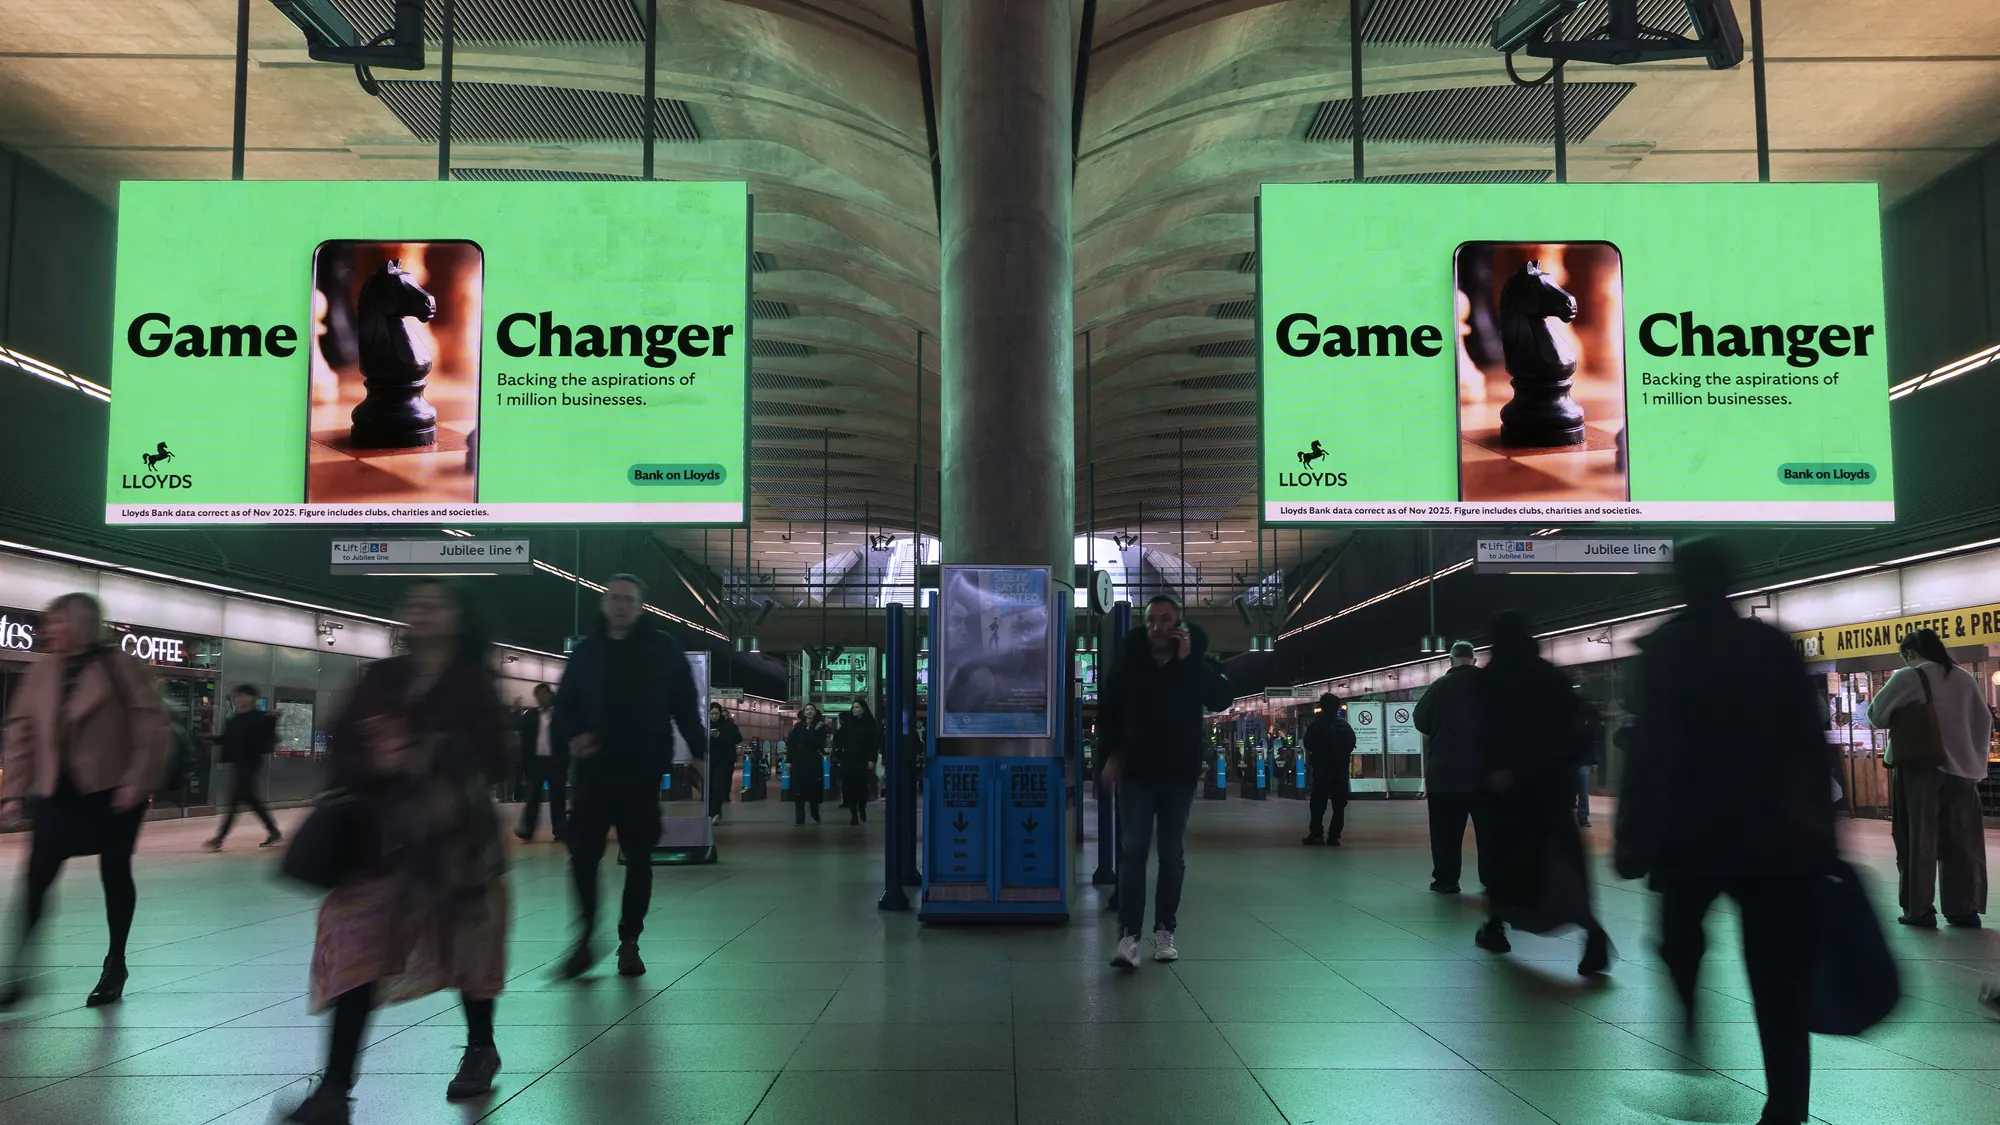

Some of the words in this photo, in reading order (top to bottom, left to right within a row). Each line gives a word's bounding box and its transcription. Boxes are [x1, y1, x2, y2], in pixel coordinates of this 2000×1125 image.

[127, 312, 298, 358] Game
[496, 310, 734, 369] Changer
[1275, 312, 1443, 358] Game
[1638, 310, 1875, 369] Changer
[498, 373, 557, 388] Backing
[561, 373, 587, 385] the
[592, 373, 674, 388] aspirations
[680, 372, 695, 385] of
[1643, 372, 1701, 388] Backing
[1705, 372, 1731, 385] the
[1736, 372, 1818, 387] aspirations
[1823, 372, 1839, 385] of
[496, 392, 502, 406] 1
[507, 393, 556, 406] million
[562, 393, 647, 406] businesses.
[1642, 392, 1648, 405] 1
[1653, 392, 1702, 405] million
[1708, 392, 1792, 405] businesses.
[122, 474, 193, 490] LLOYDS
[635, 469, 663, 480] Bank
[666, 472, 680, 480] on
[684, 469, 720, 483] Lloyds
[1279, 472, 1348, 487] LLOYDS
[1784, 468, 1813, 479] Bank
[1816, 471, 1830, 479] on
[1834, 468, 1870, 482] Lloyds
[122, 508, 150, 518] Lloyds
[152, 508, 174, 517] Bank
[176, 508, 196, 517] data
[242, 508, 252, 517] of
[254, 508, 271, 517] Nov
[273, 508, 297, 517] 2025.
[299, 508, 326, 518] Figure
[328, 508, 364, 517] includes
[365, 508, 390, 517] clubs,
[392, 508, 429, 517] charities
[431, 508, 448, 517] and
[449, 508, 490, 517] societies.
[1281, 506, 1308, 516] Lloyds
[1310, 506, 1331, 515] Bank
[1333, 506, 1353, 515] data
[1398, 506, 1408, 515] of
[1409, 506, 1427, 515] Nov
[1428, 506, 1452, 515] 2025.
[1455, 506, 1481, 516] Figure
[1482, 506, 1518, 515] includes
[1519, 506, 1544, 516] clubs,
[1546, 506, 1583, 515] charities
[1584, 506, 1601, 515] and
[1602, 506, 1643, 515] societies.
[342, 543, 358, 552] Lift
[439, 544, 484, 556] Jubilee
[489, 544, 512, 556] line
[1488, 542, 1504, 551] Lift
[1584, 543, 1629, 555] Jubilee
[1633, 543, 1656, 555] line
[994, 573, 1015, 583] SEE
[994, 583, 1015, 593] SAY
[1837, 625, 1891, 651] ARTISAN
[1955, 615, 1966, 638] &
[121, 633, 183, 663] COFFEE
[943, 773, 979, 792] FREE
[1011, 773, 1047, 792] FREE
